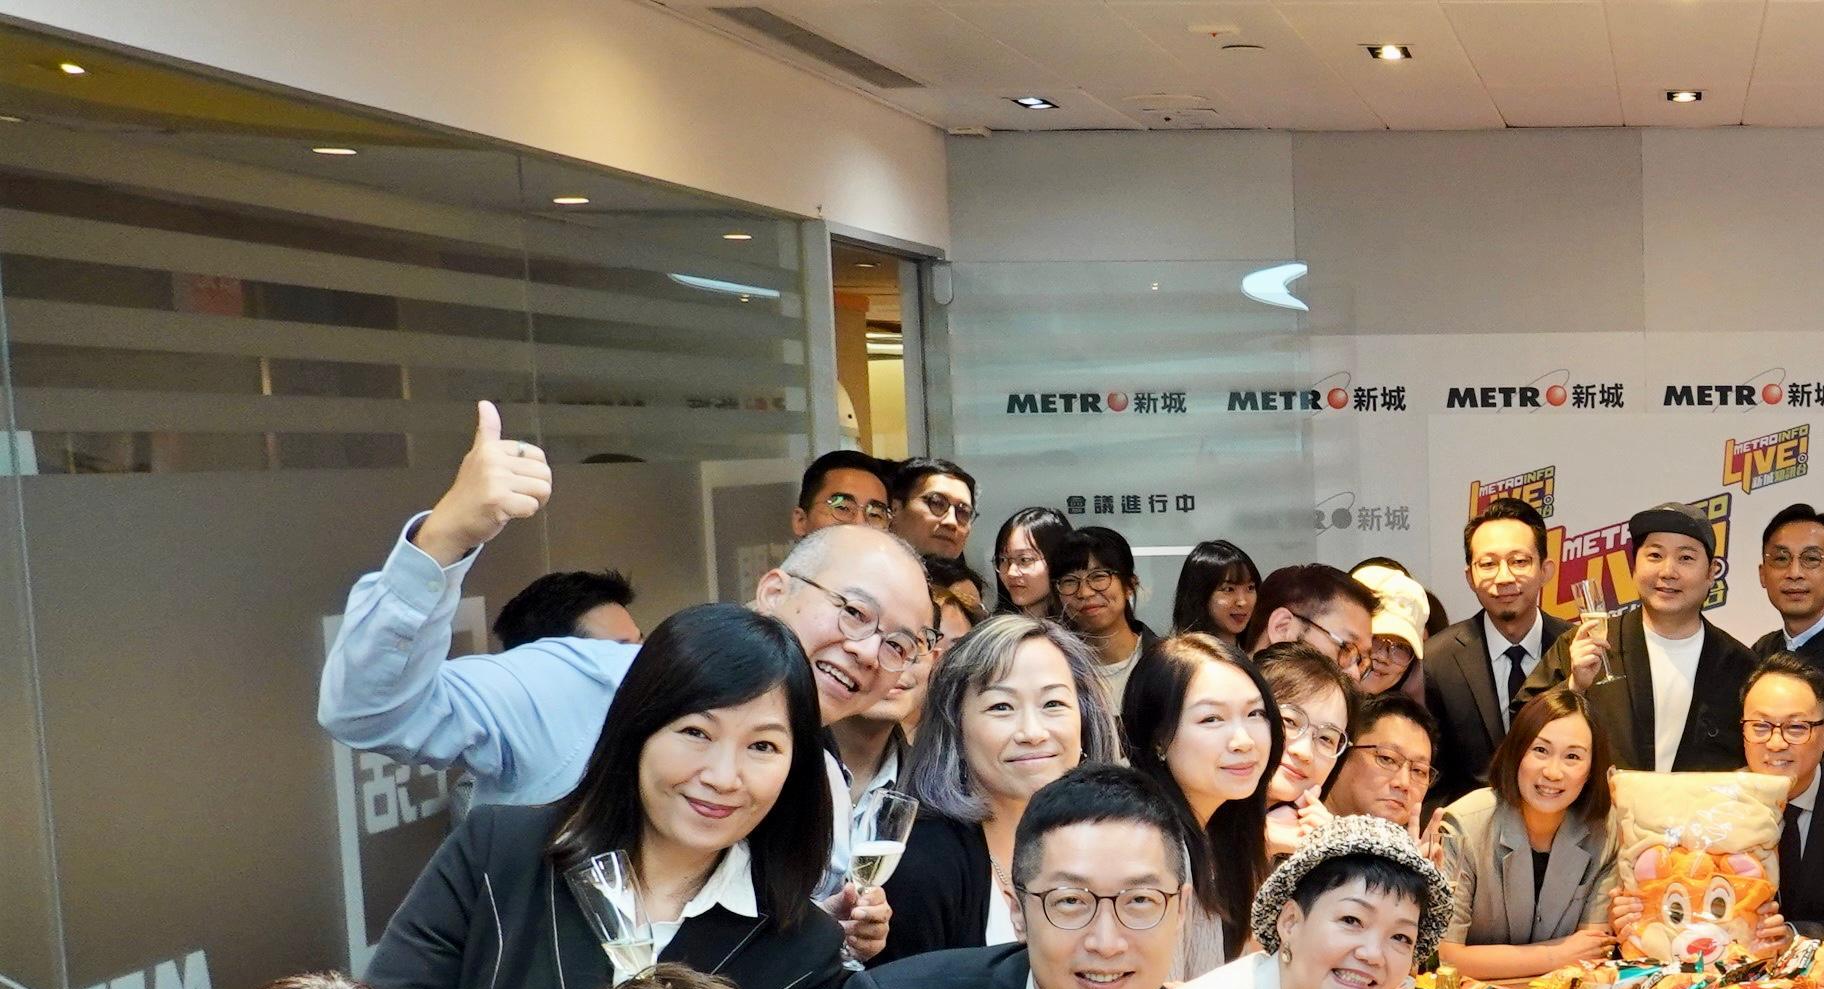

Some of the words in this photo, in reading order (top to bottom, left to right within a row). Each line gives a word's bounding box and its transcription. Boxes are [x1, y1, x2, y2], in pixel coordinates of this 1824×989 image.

[1133, 391, 1187, 414] 新城
[1353, 386, 1407, 412] 新城
[1447, 385, 1567, 408] METRO
[1572, 383, 1624, 409] 新城
[1664, 383, 1783, 407] METRO
[1723, 436, 1808, 494] LIVE!
[1066, 494, 1195, 515] 會議進行中
[1357, 506, 1410, 531] 新城
